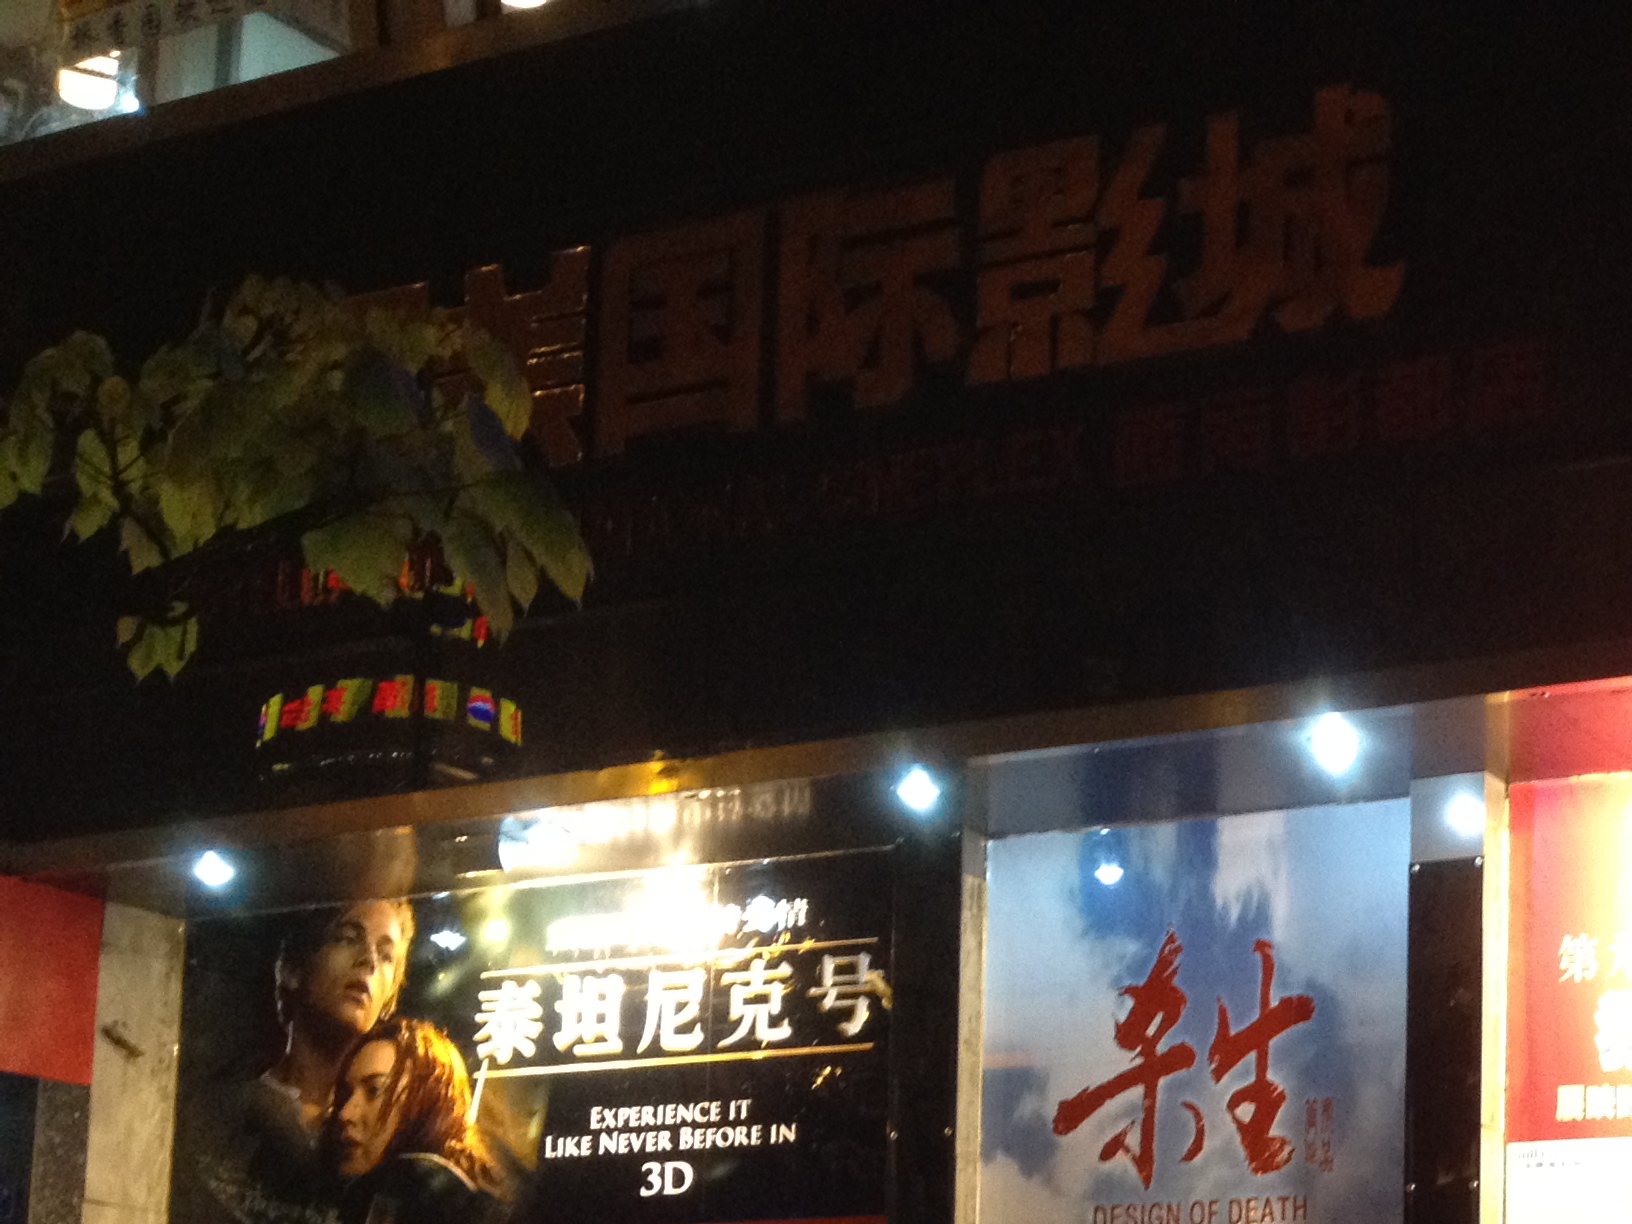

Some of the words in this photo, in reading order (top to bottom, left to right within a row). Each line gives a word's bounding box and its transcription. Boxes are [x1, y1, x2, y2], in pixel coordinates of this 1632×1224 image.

[347, 84, 1404, 464] 美国际影城
[474, 952, 874, 1065] 泰坦尼克号
[590, 1101, 721, 1129] EXPERIENCE
[729, 1099, 752, 1121] IT
[545, 1135, 592, 1158] LIKE
[599, 1130, 672, 1155] NEVER
[679, 1125, 763, 1150] BEFORE
[771, 1123, 797, 1144] IN
[640, 1161, 694, 1197] 3D
